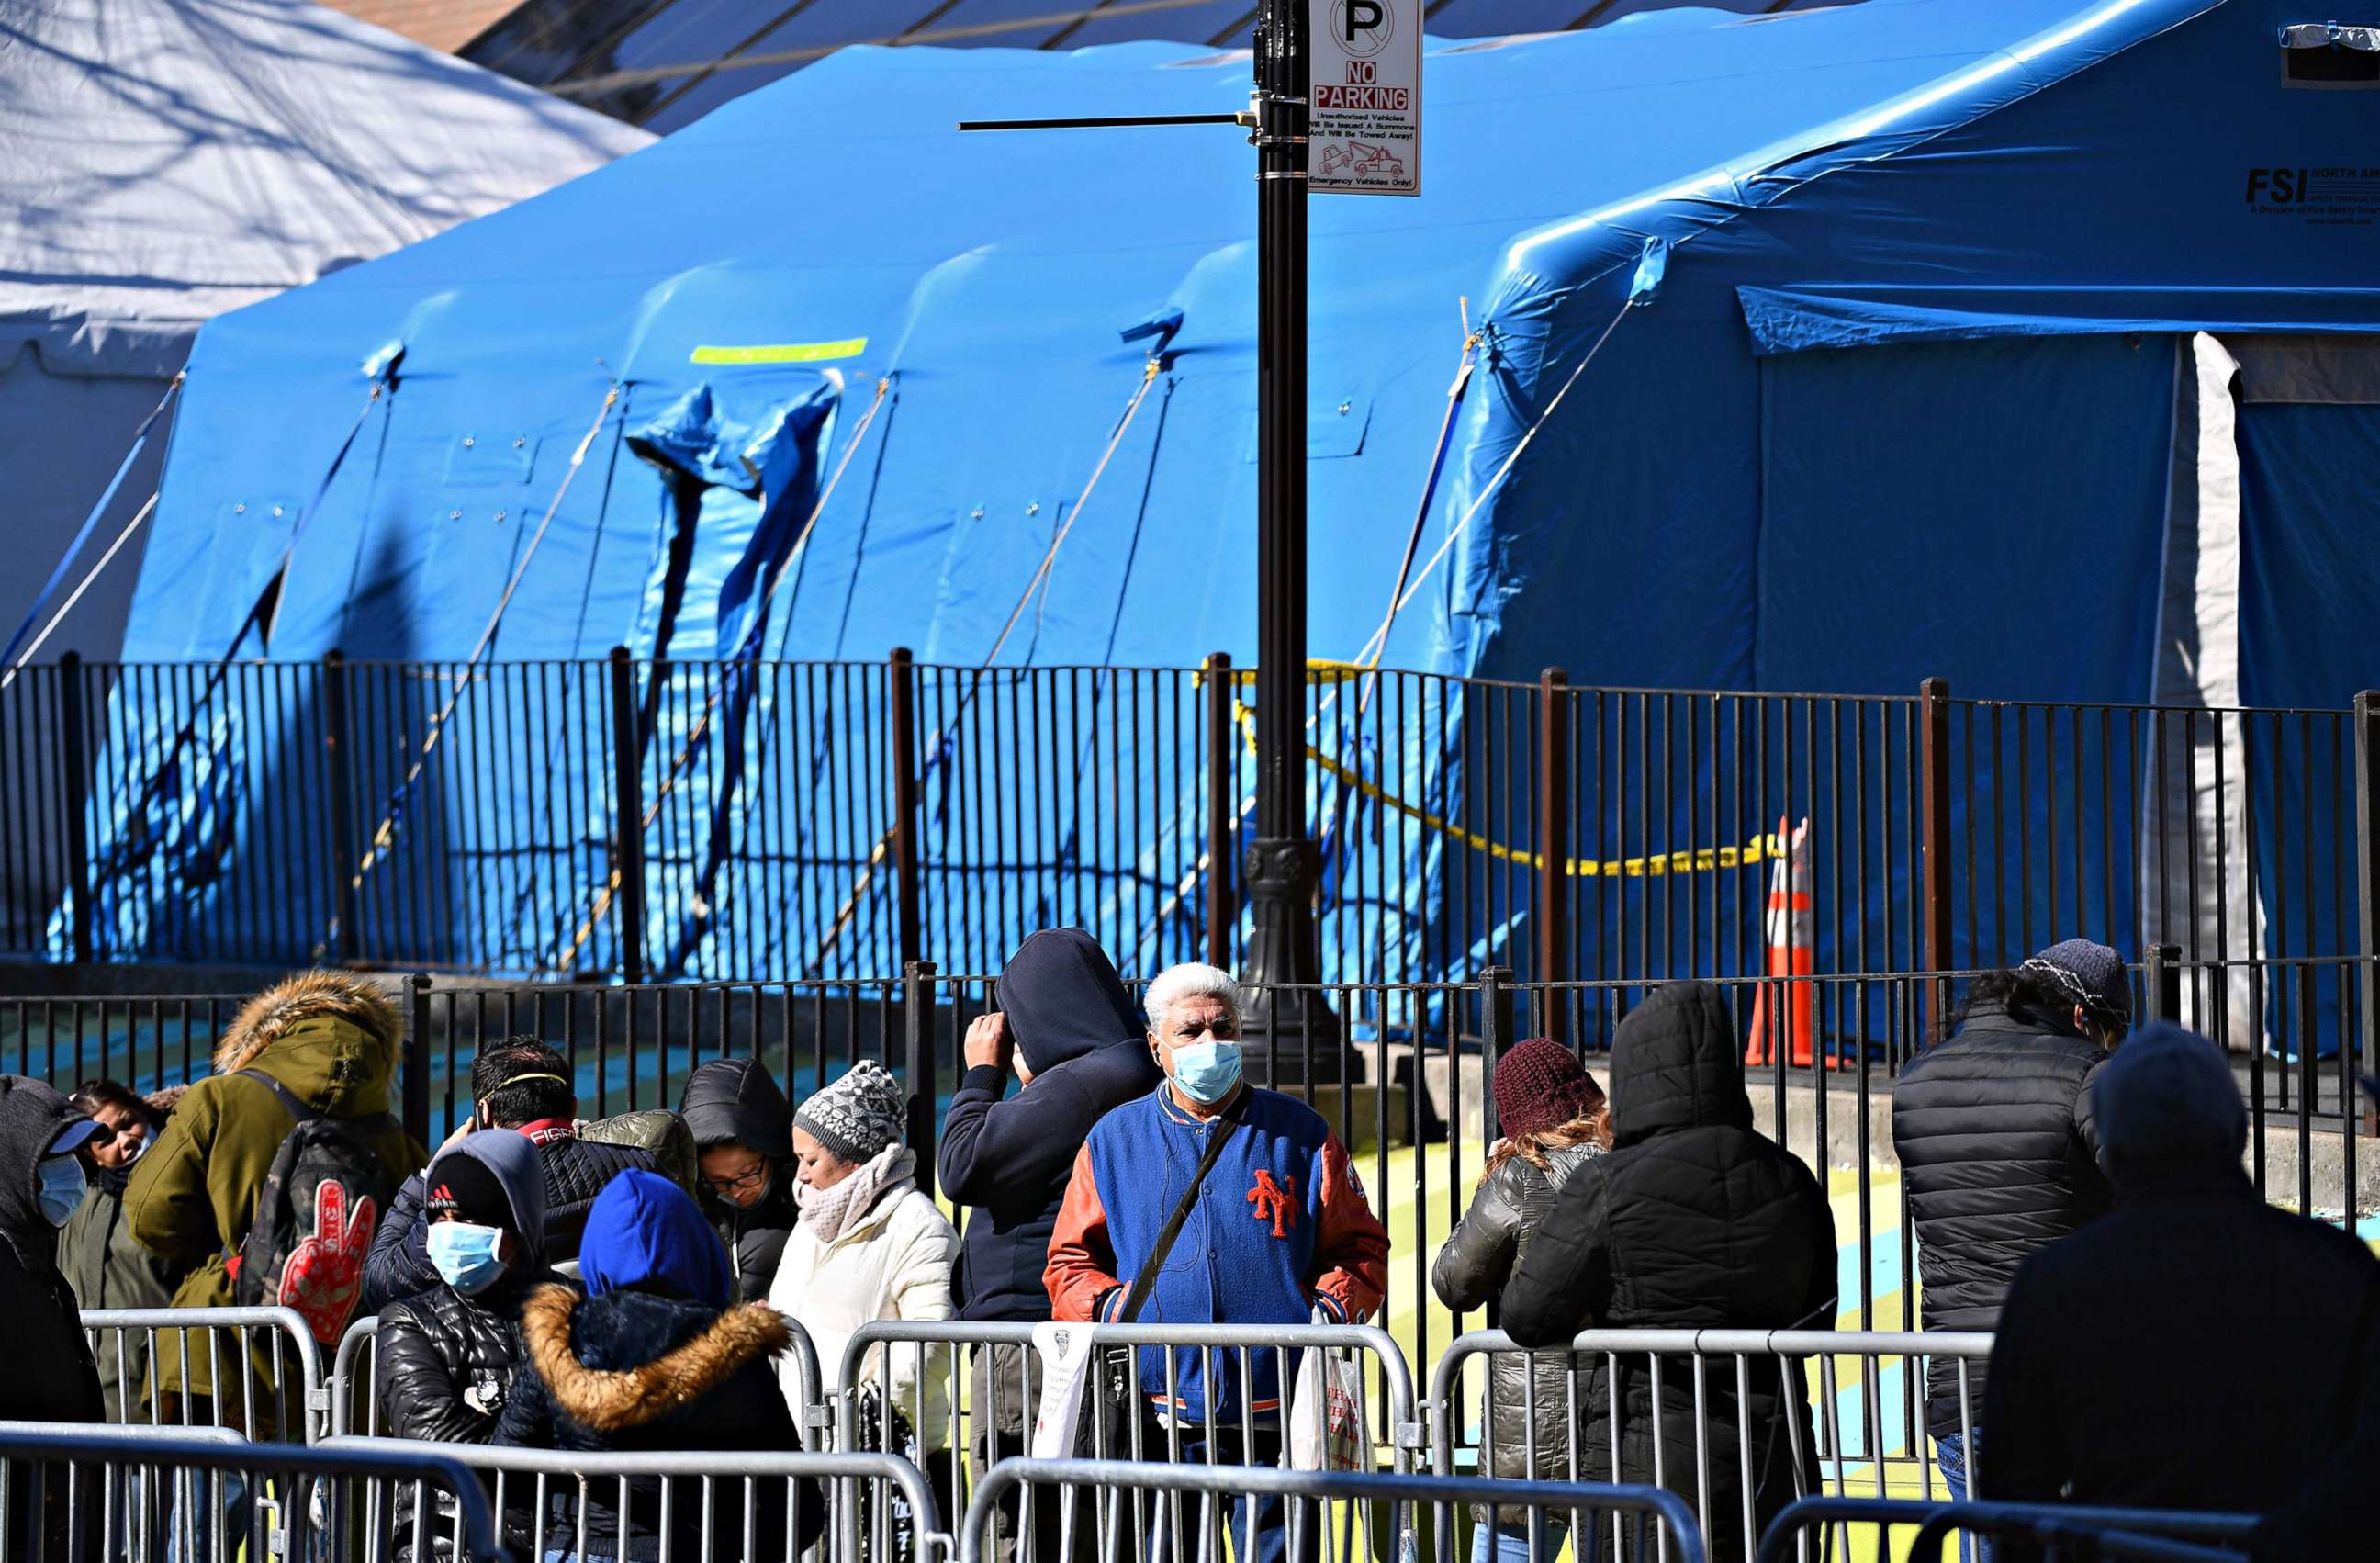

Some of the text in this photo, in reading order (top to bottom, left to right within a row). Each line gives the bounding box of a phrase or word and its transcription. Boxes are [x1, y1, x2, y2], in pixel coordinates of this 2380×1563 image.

[1345, 0, 1383, 41] P
[1347, 62, 1375, 84] NO
[1316, 86, 1407, 109] PARKING
[1317, 112, 1368, 120] Unauthorized
[1309, 176, 1353, 186] Emergency
[2310, 168, 2356, 178] NORTH
[2246, 168, 2307, 203] FSI
